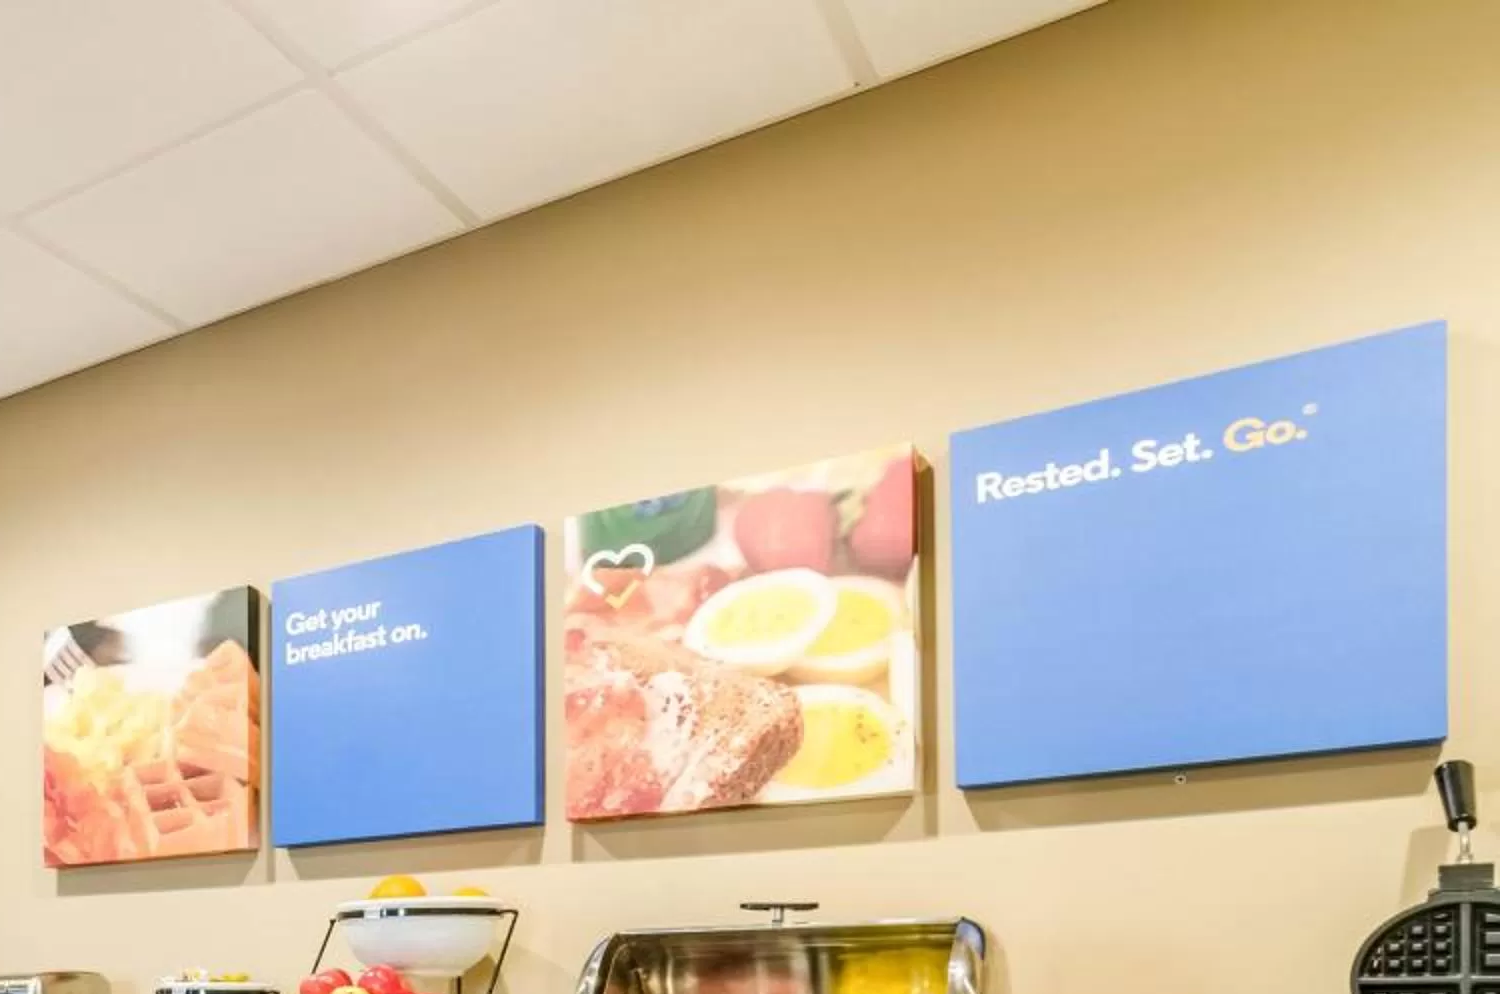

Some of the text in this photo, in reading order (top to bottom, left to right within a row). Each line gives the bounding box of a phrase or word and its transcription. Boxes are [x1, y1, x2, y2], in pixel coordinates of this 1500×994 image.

[976, 449, 1121, 504] Rested.
[1131, 432, 1214, 473] Set.
[285, 601, 382, 636] Get your
[285, 623, 428, 665] breakfast on.
